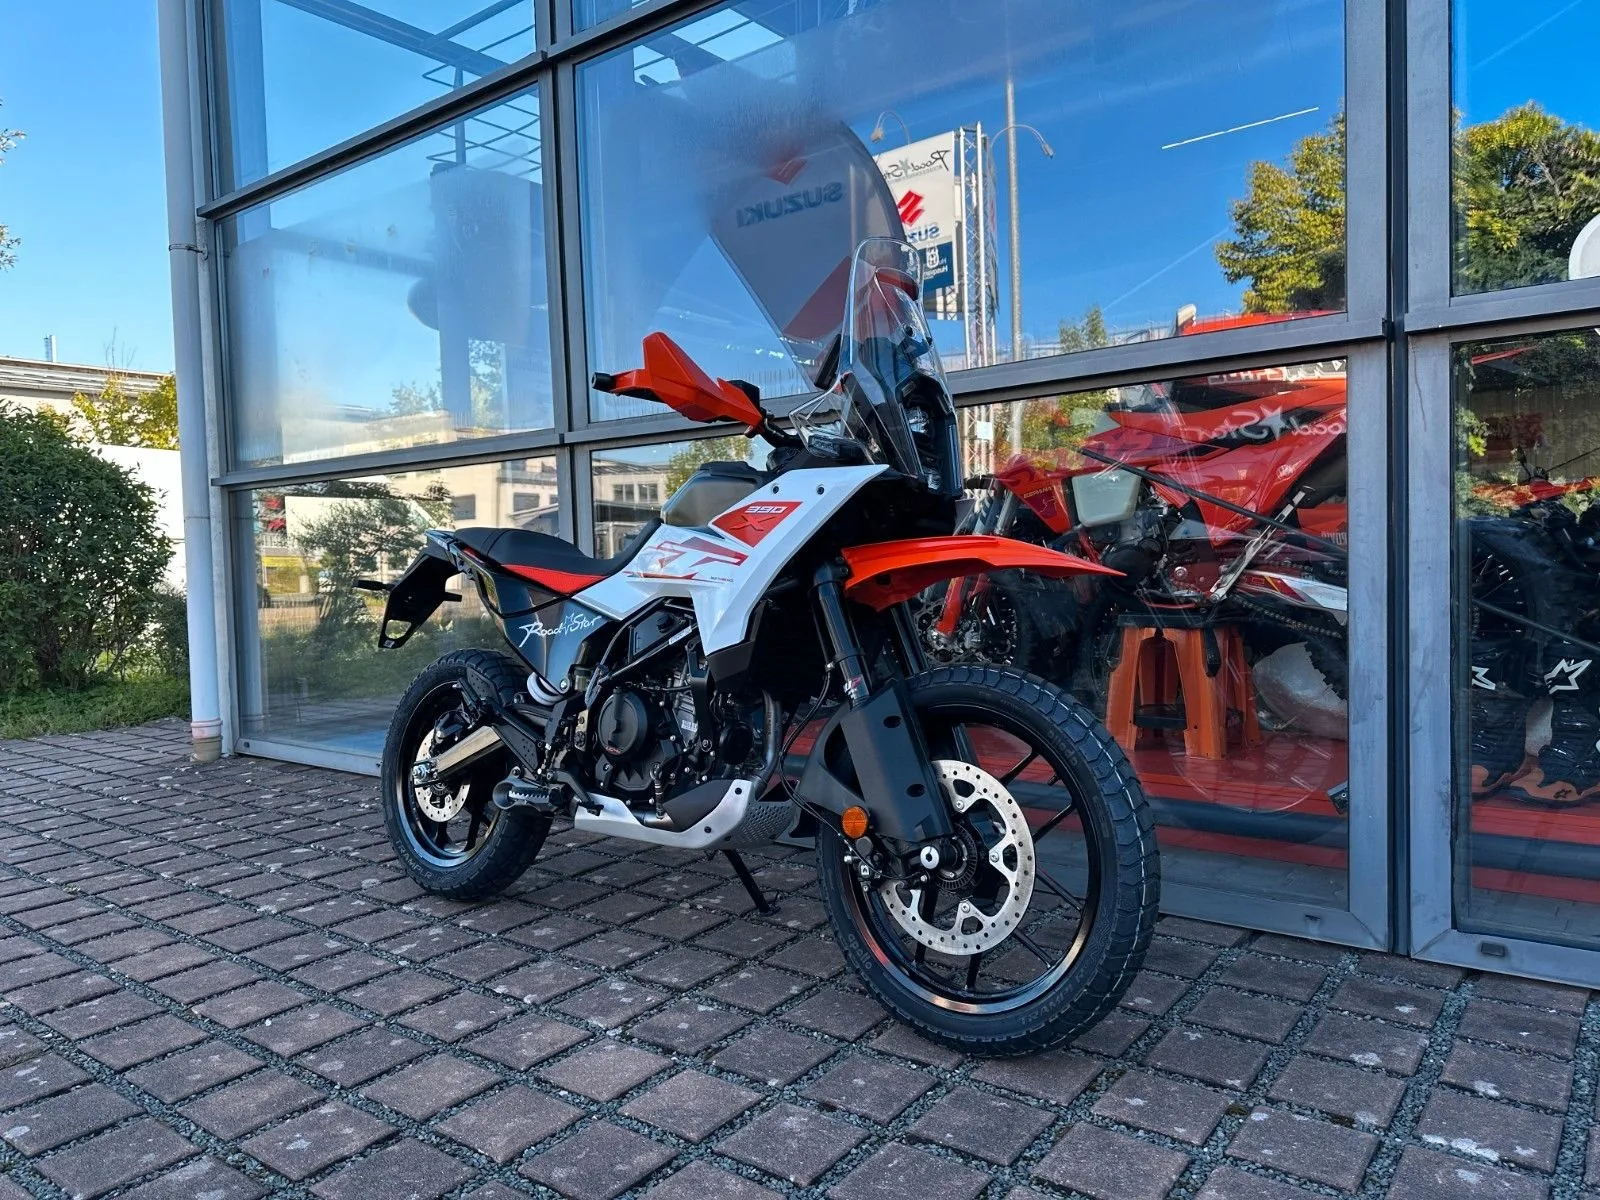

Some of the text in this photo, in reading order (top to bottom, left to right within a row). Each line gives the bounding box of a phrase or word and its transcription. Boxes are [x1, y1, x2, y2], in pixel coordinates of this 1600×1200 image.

[744, 505, 788, 514] 390
[518, 613, 602, 648] Road Star
[848, 933, 872, 970] apollo
